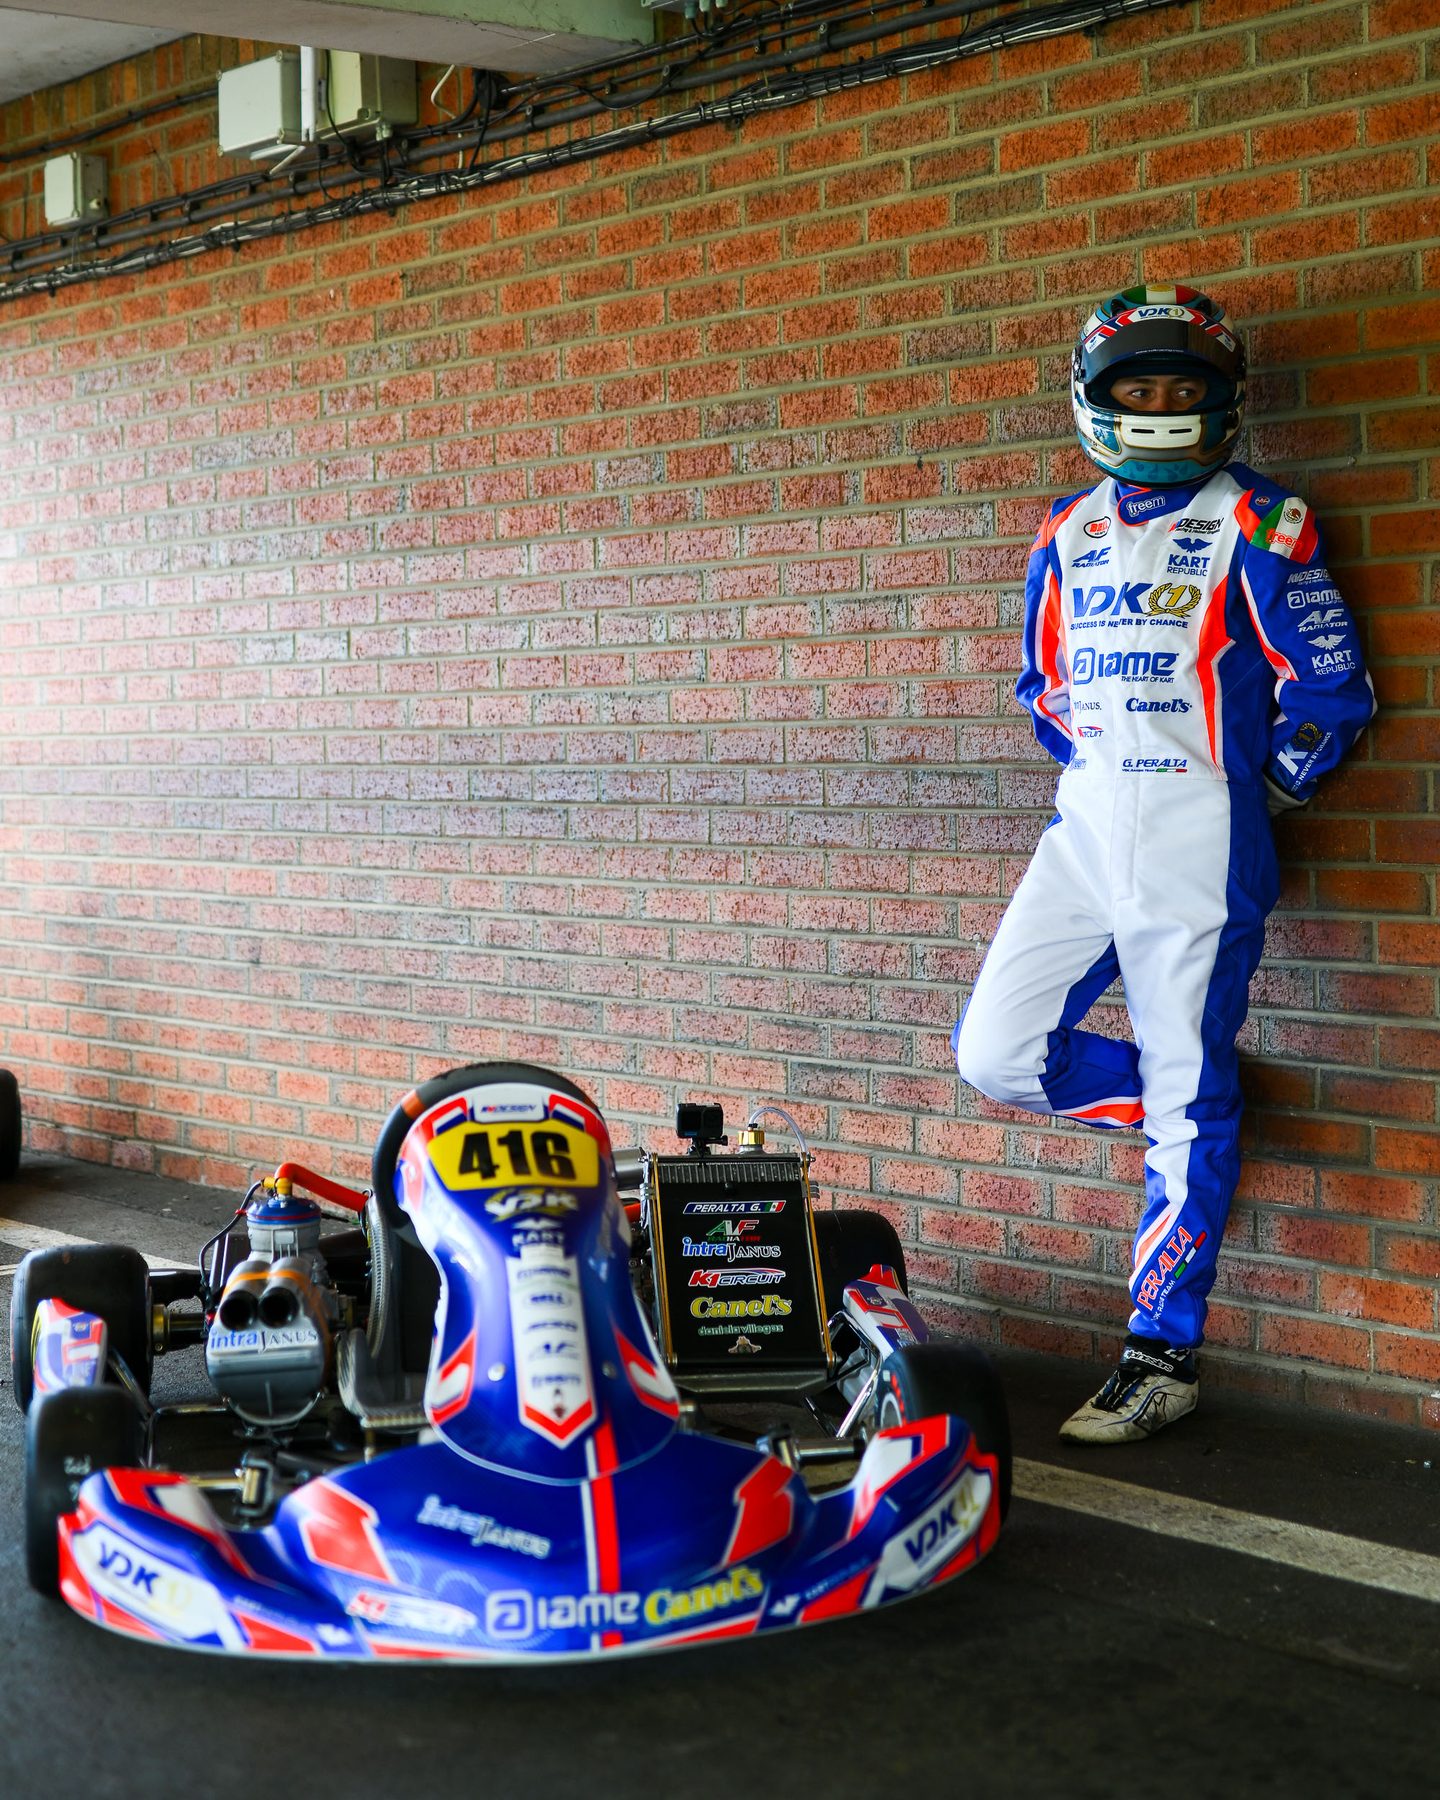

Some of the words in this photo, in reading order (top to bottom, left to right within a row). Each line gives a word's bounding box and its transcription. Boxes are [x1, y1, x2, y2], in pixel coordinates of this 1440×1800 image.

[1138, 307, 1169, 318] VDK
[1126, 496, 1165, 517] freem
[1072, 546, 1112, 562] AF
[1168, 554, 1211, 568] KART
[1166, 566, 1208, 577] REPUBLIC
[1072, 582, 1153, 618] VDK
[1165, 584, 1188, 608] 1
[1135, 618, 1148, 626] BY
[1149, 618, 1189, 629] CHANCE
[1298, 608, 1345, 627] AF
[1298, 621, 1348, 633] RADIATOR
[1311, 650, 1352, 669] KART
[1315, 661, 1356, 676] REPUBLIC
[1126, 697, 1190, 714] Canel's
[1123, 759, 1133, 768] G.
[1136, 758, 1188, 768] PERALTA
[458, 1129, 577, 1181] 416
[692, 1203, 745, 1213] PERALTA
[750, 1203, 761, 1212] G.
[1136, 1225, 1193, 1311] PERALTA
[690, 1295, 793, 1318] Canel's
[905, 1500, 958, 1563] VDK
[98, 1540, 161, 1595] VDK
